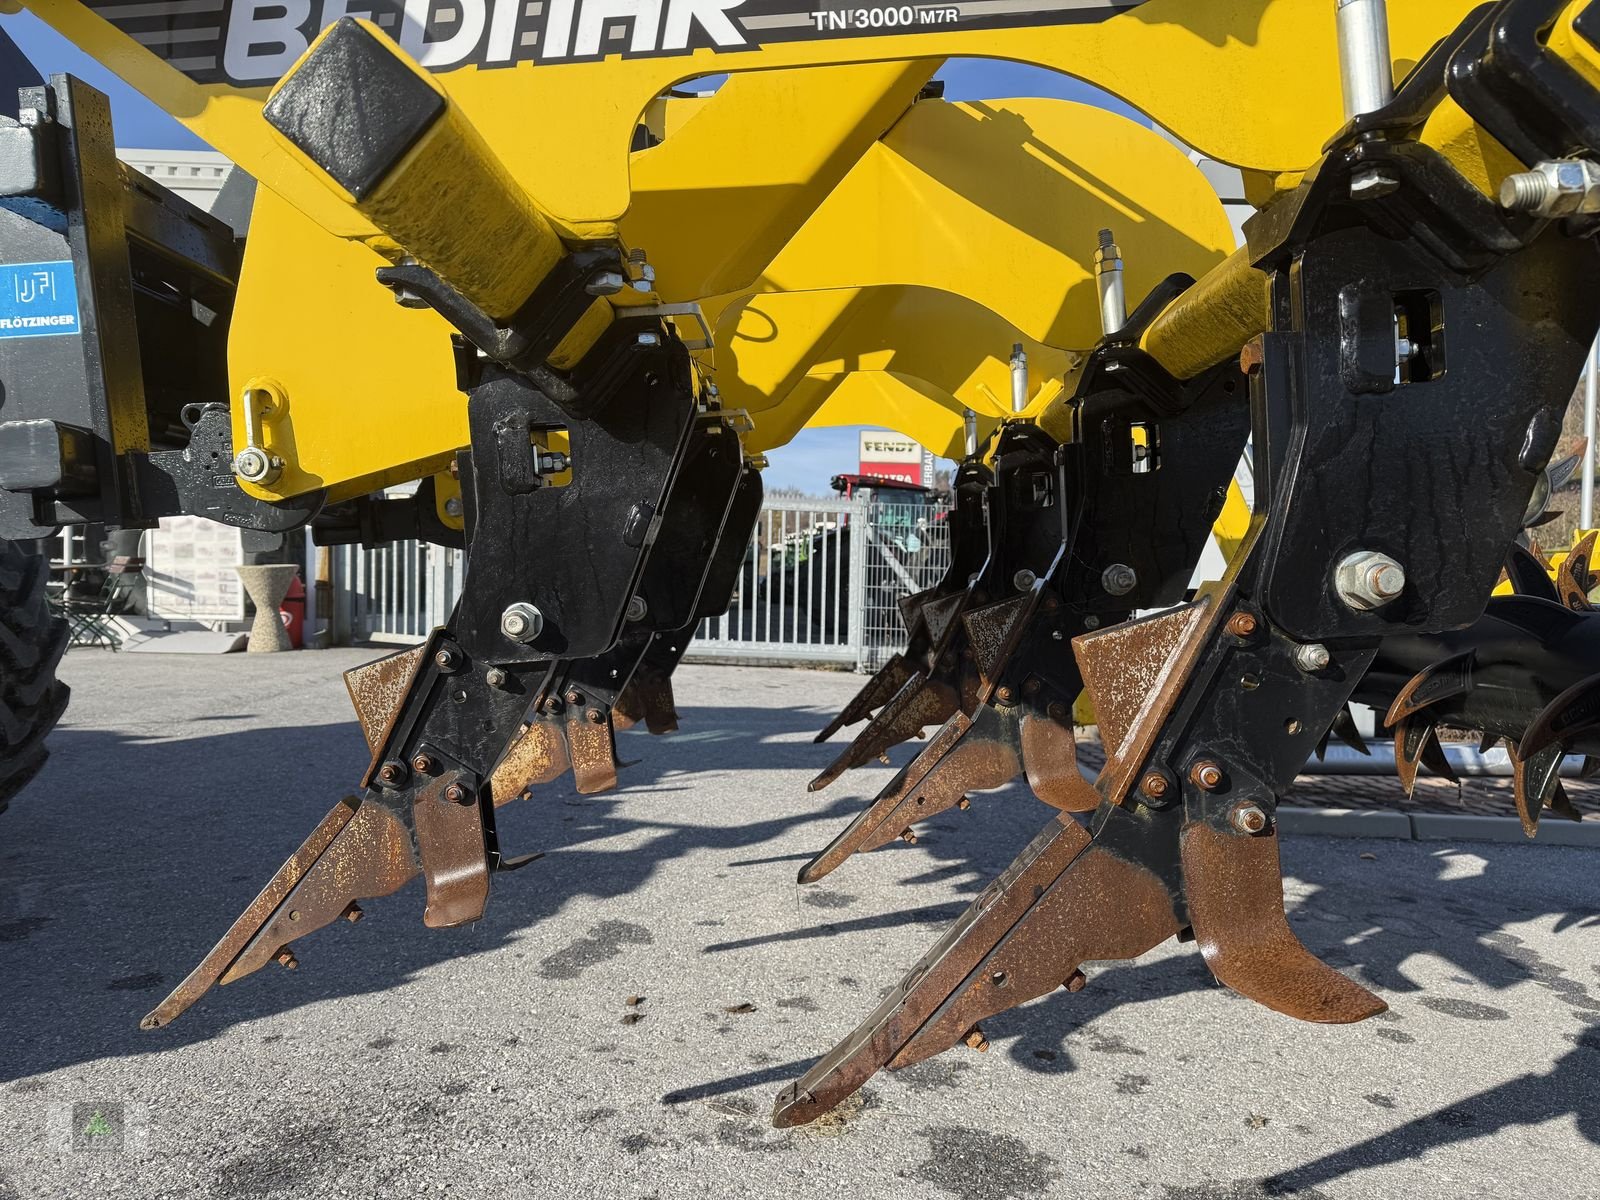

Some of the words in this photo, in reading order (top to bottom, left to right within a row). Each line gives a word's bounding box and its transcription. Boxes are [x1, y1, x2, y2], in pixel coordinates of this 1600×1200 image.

[812, 10, 847, 31] TN
[855, 6, 913, 29] 3000
[920, 9, 958, 25] M7R
[0, 315, 75, 329] FLÖTZINGER
[864, 441, 917, 452] FENDT
